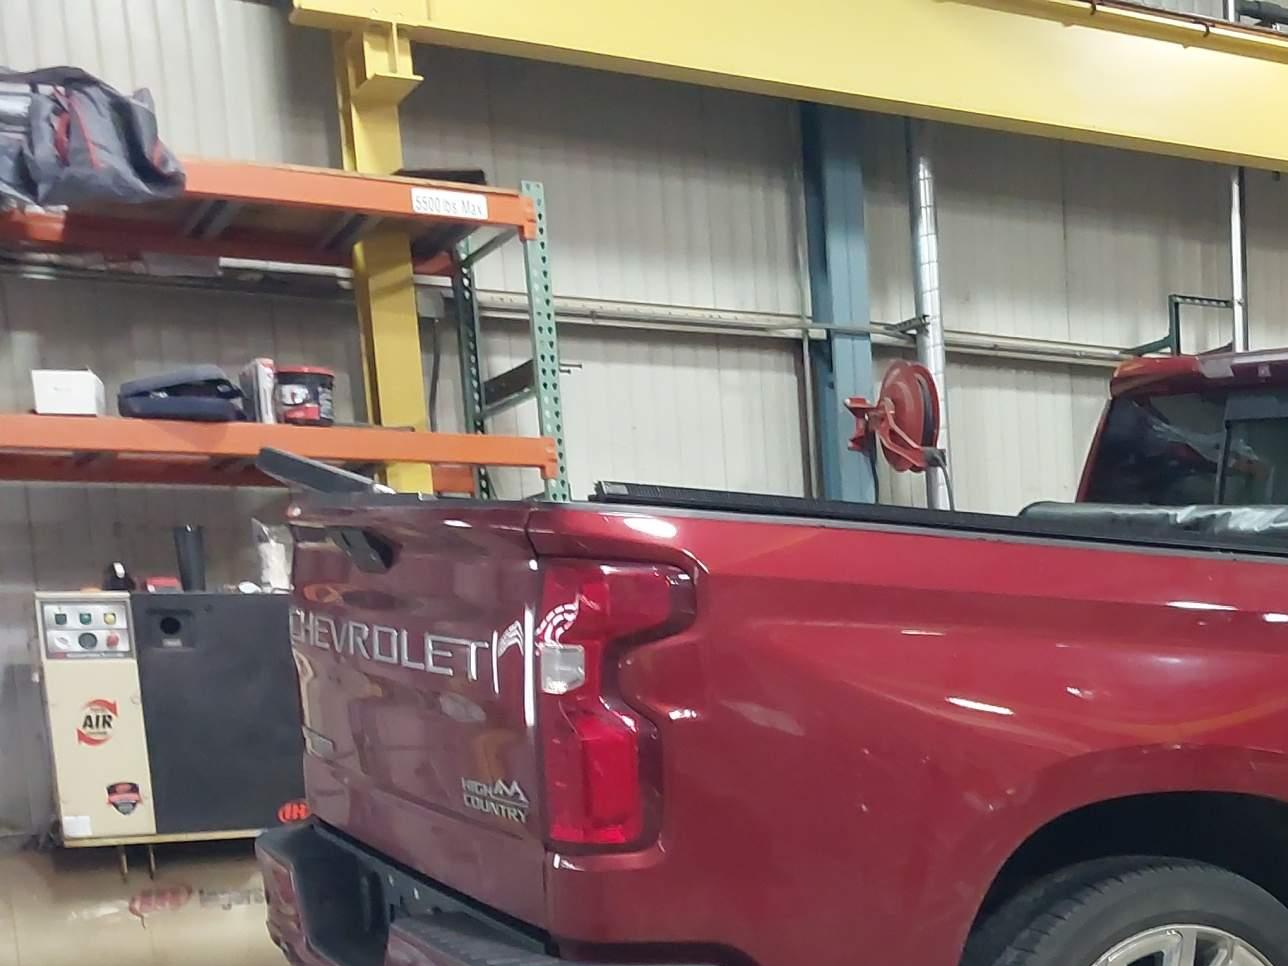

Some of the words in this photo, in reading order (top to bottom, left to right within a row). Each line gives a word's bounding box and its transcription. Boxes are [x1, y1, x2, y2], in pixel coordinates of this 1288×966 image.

[415, 195, 441, 213] 5500
[461, 199, 483, 216] Max
[288, 607, 488, 681] CHEVROLET
[82, 714, 112, 729] AIR
[463, 791, 526, 824] COUNTRY
